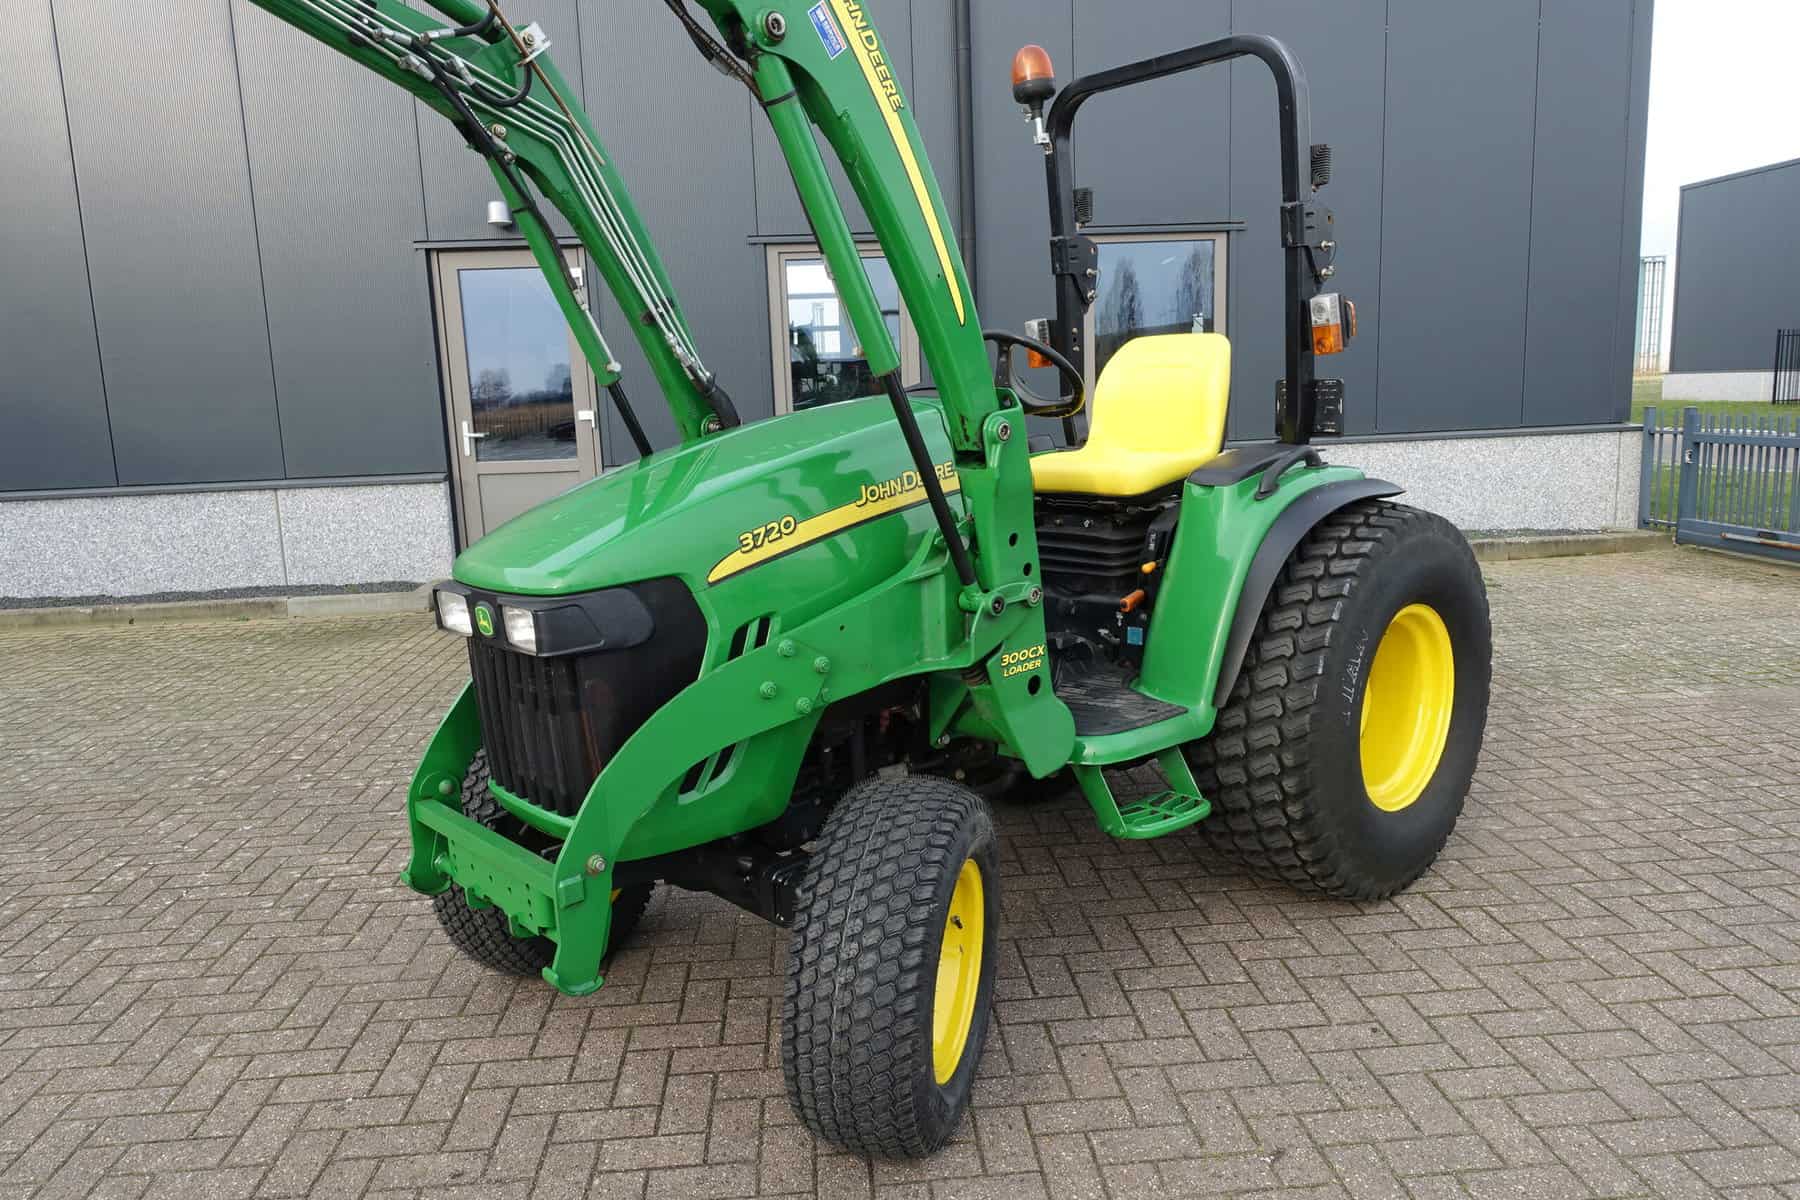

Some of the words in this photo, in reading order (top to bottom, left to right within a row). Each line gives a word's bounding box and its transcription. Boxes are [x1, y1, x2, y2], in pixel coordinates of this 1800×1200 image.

[859, 29, 904, 112] DEERE
[855, 477, 903, 507] JOHN
[902, 461, 954, 491] DERE
[738, 515, 797, 553] 3720
[1001, 644, 1045, 667] 300CX
[1003, 659, 1041, 677] LOADER
